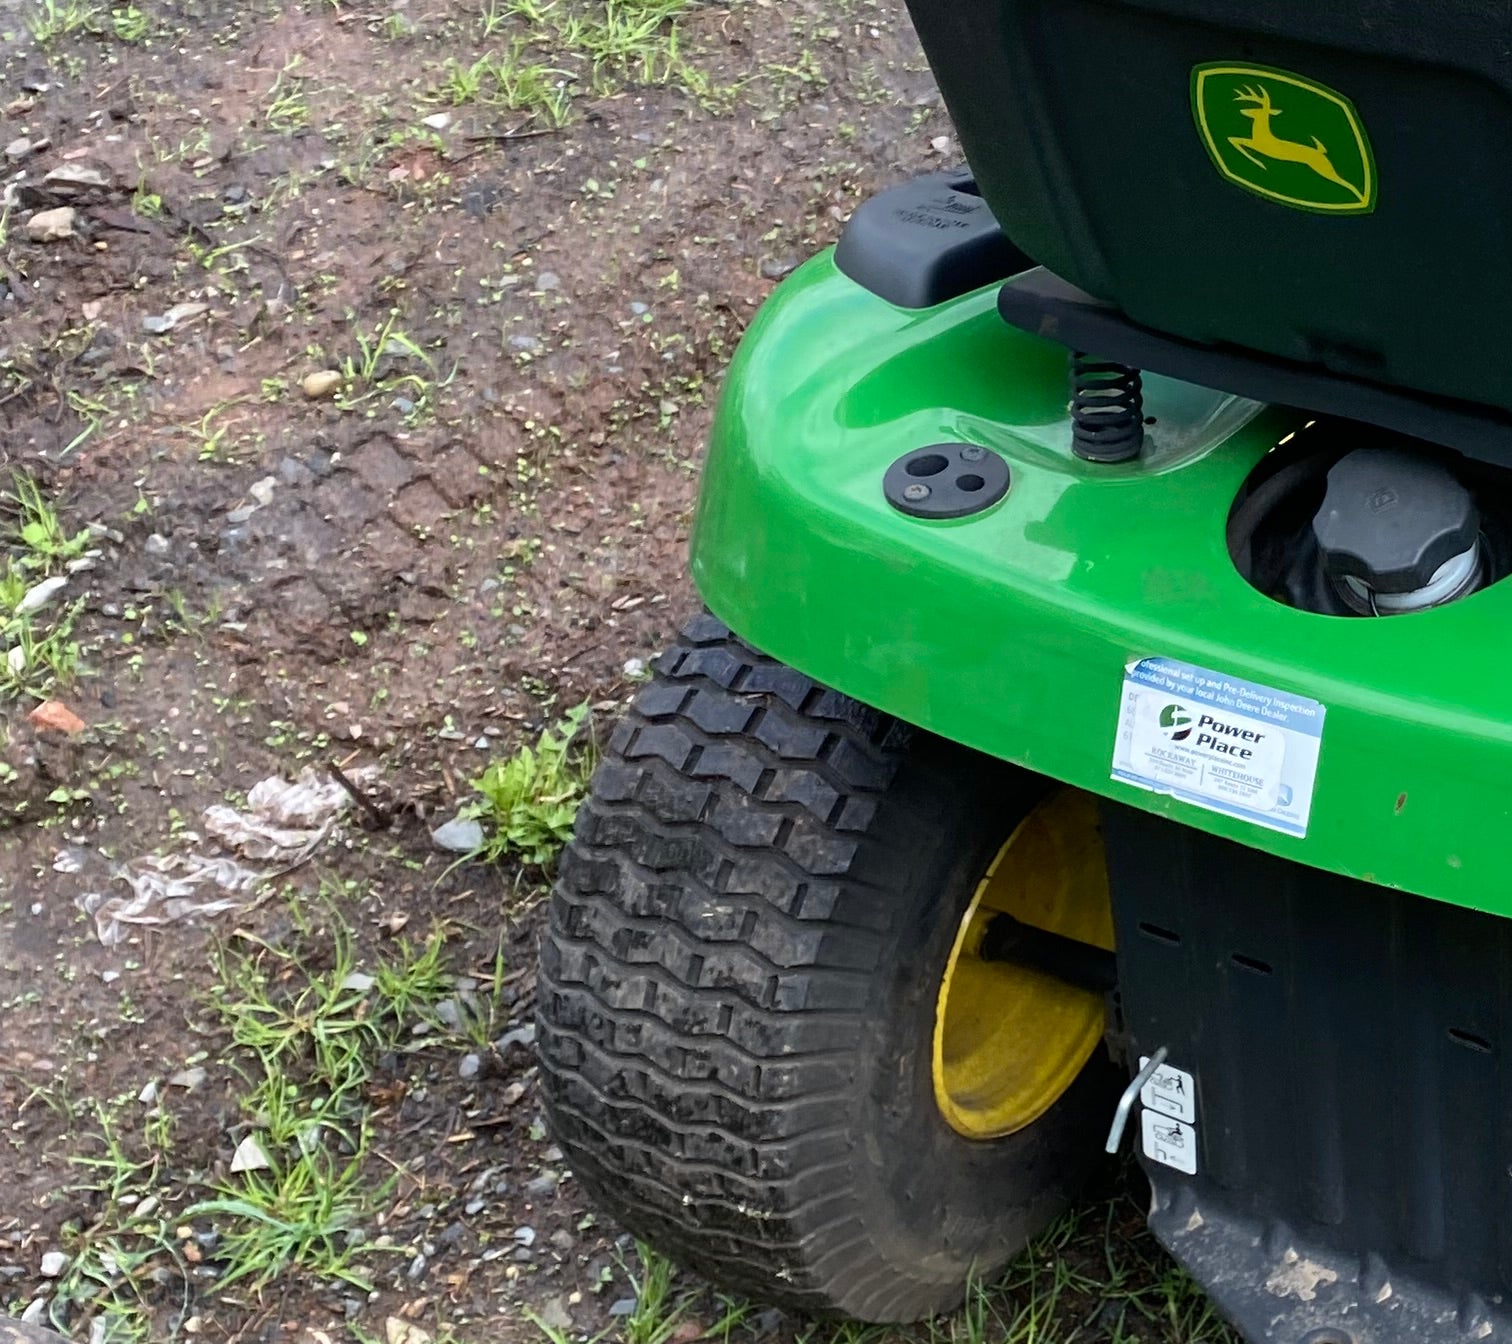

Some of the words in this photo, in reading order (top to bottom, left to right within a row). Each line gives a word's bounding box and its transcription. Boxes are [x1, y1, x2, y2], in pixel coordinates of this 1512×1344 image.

[1130, 670, 1165, 686] provided
[1166, 677, 1175, 691] by
[1176, 684, 1195, 694] your
[1195, 687, 1215, 700] local
[1216, 694, 1235, 707] John
[1236, 699, 1260, 714] Deere
[1140, 660, 1180, 677] ofessional
[1195, 677, 1206, 687] up
[1206, 679, 1222, 690] and
[1223, 682, 1272, 706] Pre-Delivery
[1273, 697, 1316, 716] Inspection
[1197, 714, 1266, 745] Power
[1196, 735, 1254, 761] Place
[1211, 765, 1264, 787] WHITEHOUSE
